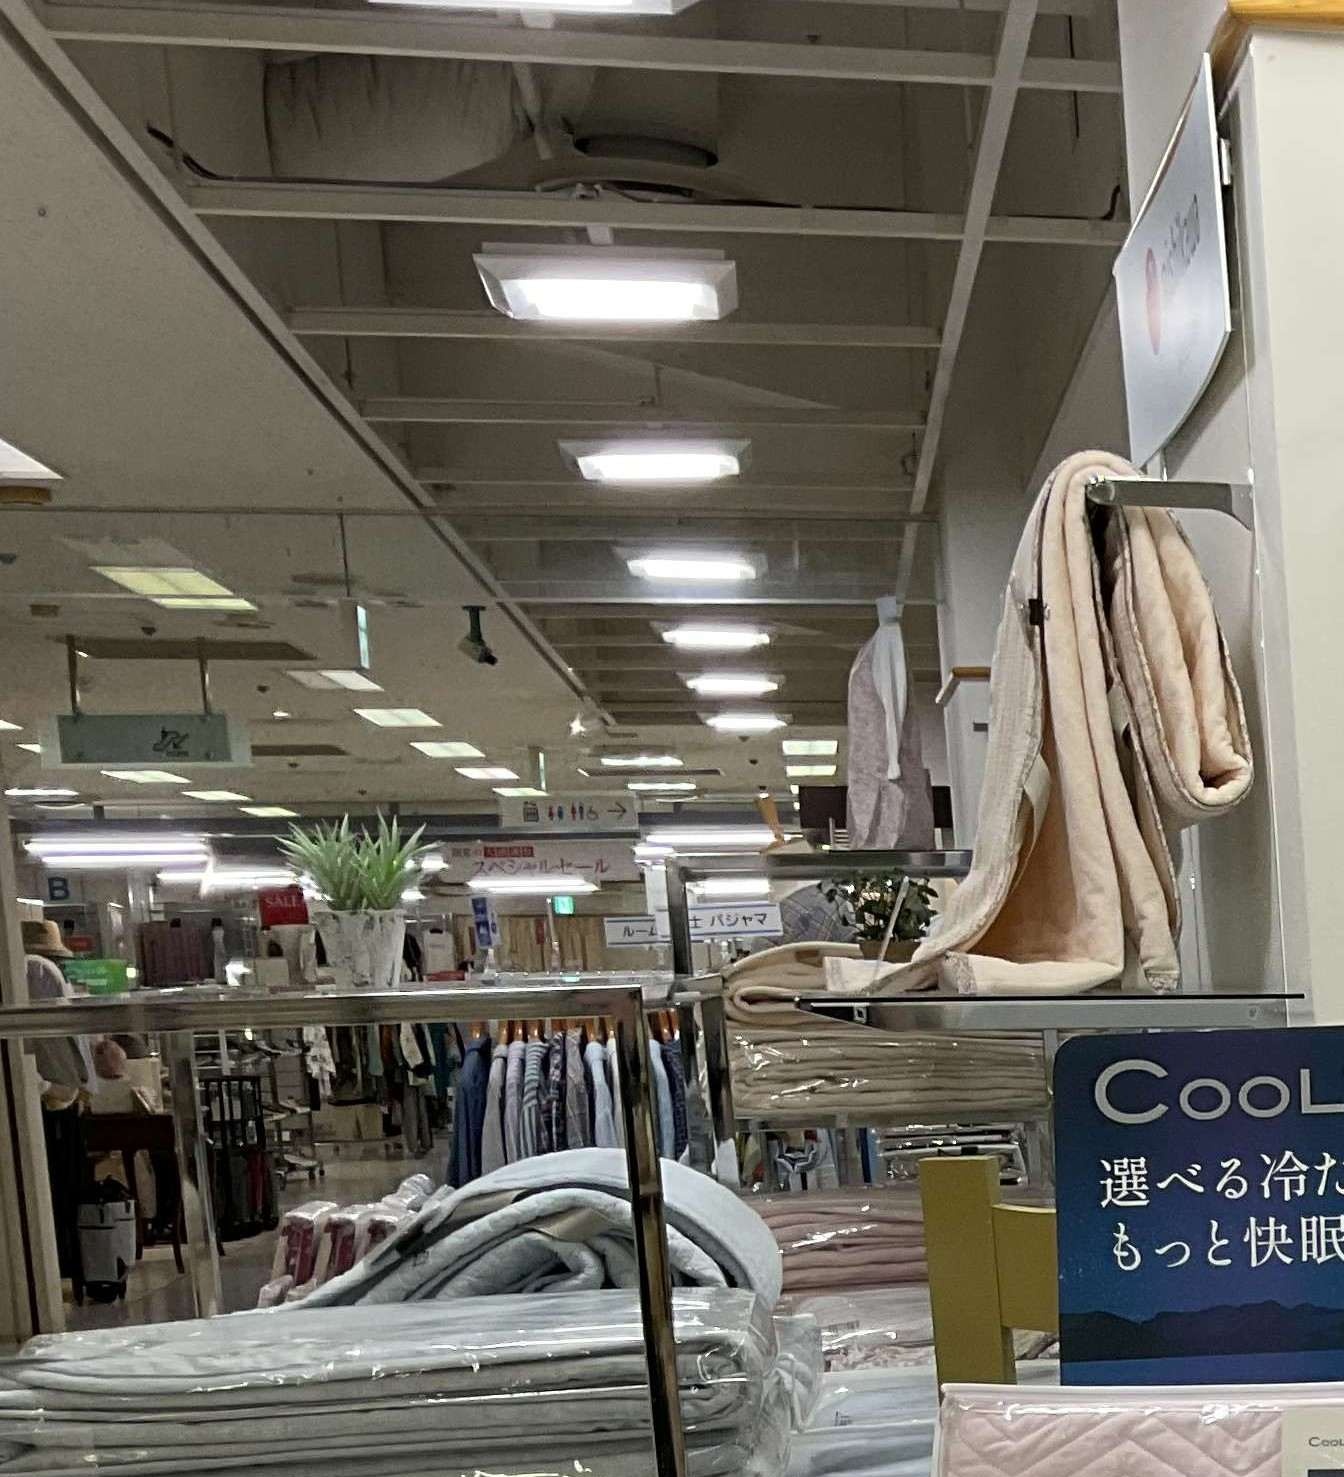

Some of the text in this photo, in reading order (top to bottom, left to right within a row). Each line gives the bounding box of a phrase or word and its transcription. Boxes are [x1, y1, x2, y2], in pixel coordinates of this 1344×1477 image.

[48, 877, 70, 900] B
[710, 911, 768, 928] パジャマ
